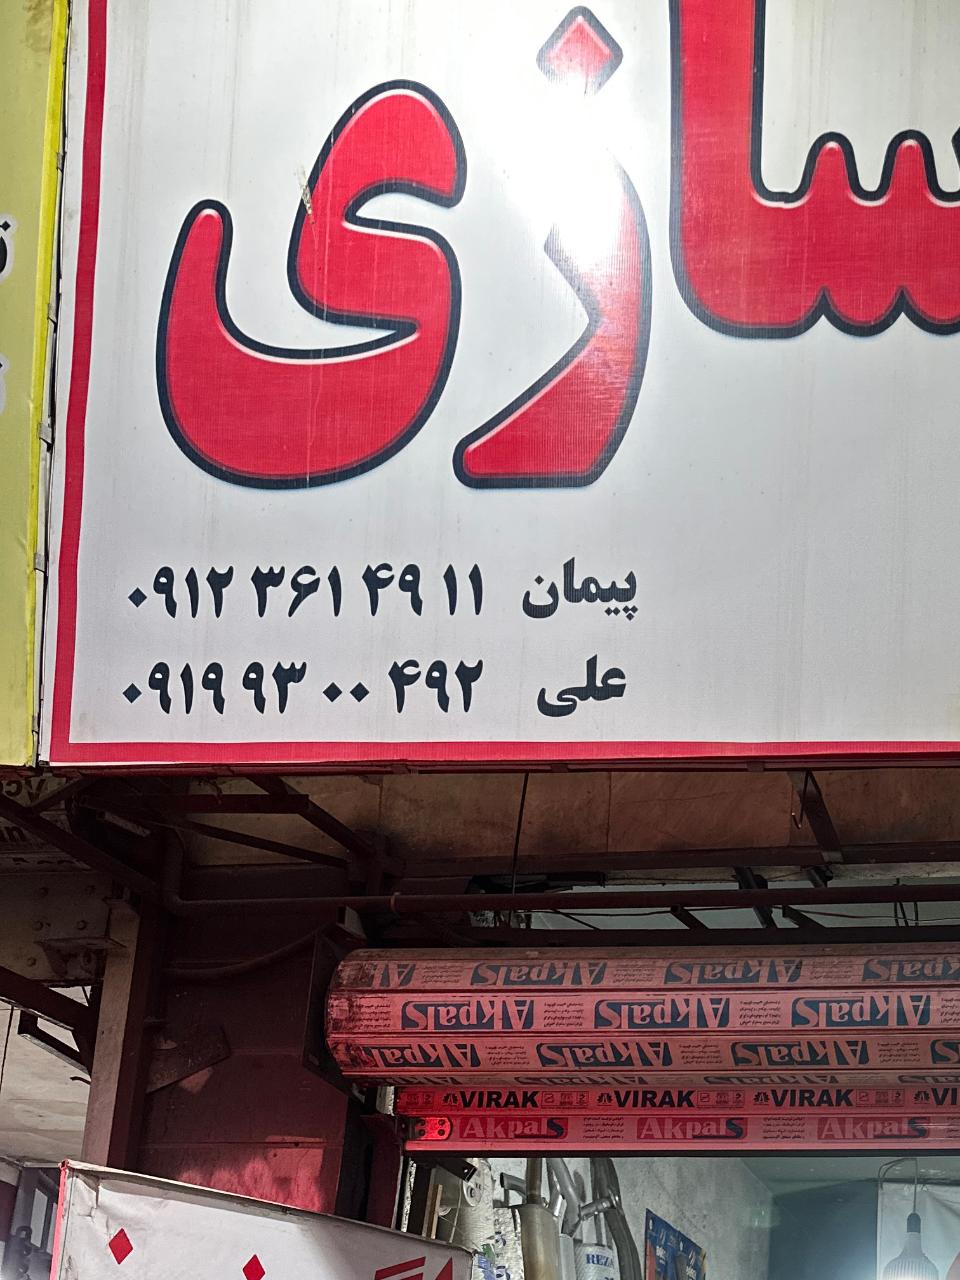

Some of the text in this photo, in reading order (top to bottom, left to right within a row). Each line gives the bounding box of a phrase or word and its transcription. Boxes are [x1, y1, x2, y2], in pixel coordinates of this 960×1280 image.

[523, 558, 637, 620] پیمان
[538, 655, 626, 717] علی
[459, 1090, 539, 1108] VIRAK
[614, 1089, 696, 1108] VIRAK
[770, 1088, 854, 1107] VIRAK
